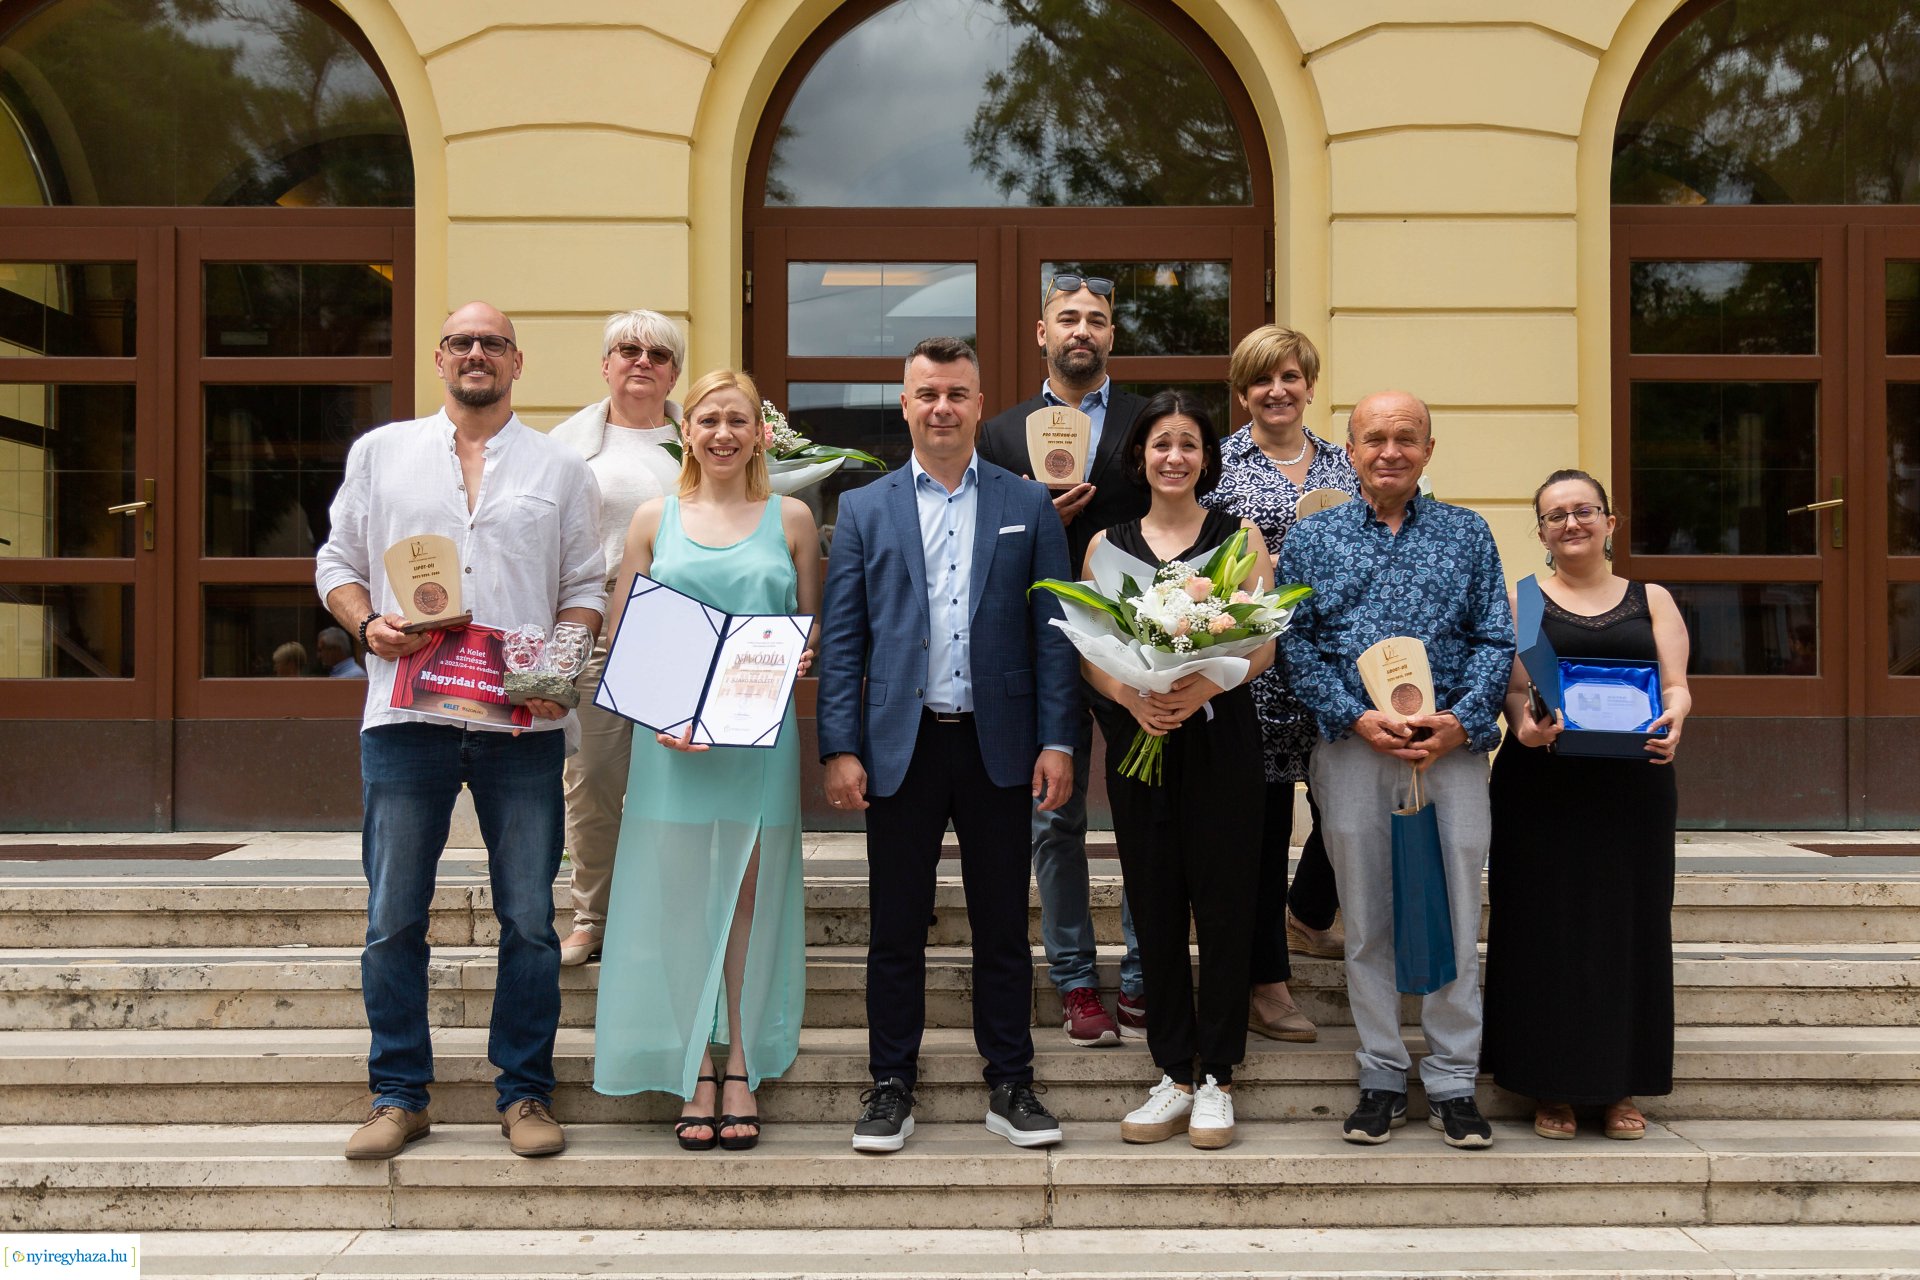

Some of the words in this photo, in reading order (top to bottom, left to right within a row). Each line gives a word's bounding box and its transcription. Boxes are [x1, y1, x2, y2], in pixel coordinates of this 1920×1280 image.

[467, 648, 486, 658] Kelet
[420, 670, 475, 689] Nagyidai
[477, 681, 509, 696] Gerg
